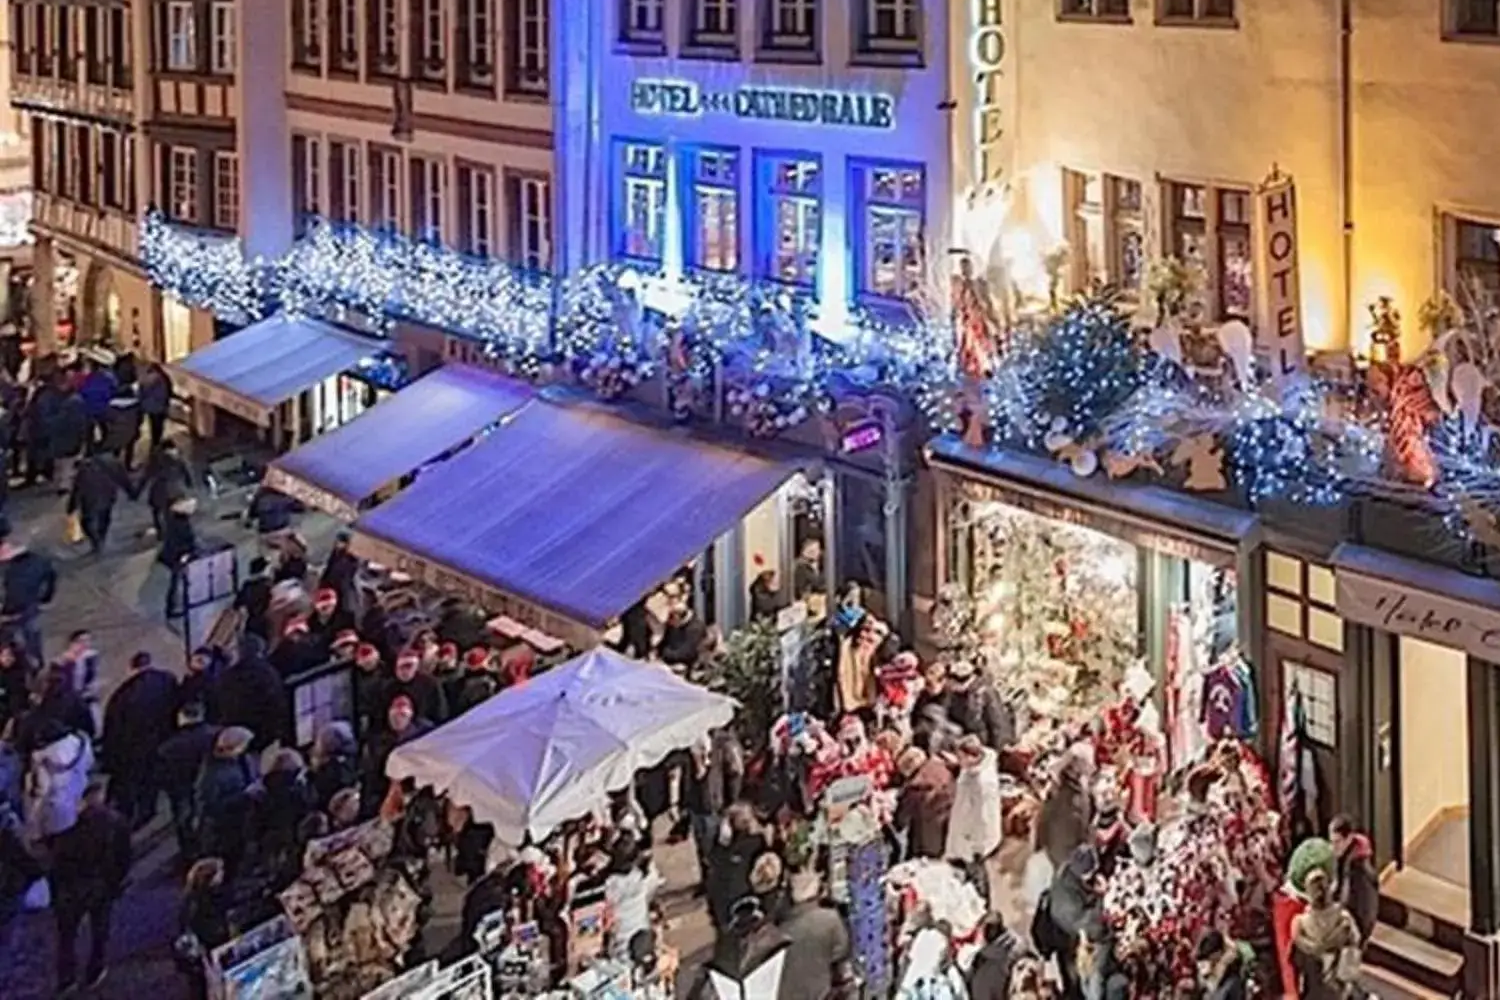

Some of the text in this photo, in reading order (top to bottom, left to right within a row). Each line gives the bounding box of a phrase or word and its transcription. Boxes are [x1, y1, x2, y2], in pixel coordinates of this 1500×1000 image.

[632, 80, 892, 128] HOTEL CATHEDRALE
[1267, 192, 1294, 375] HOTEL
